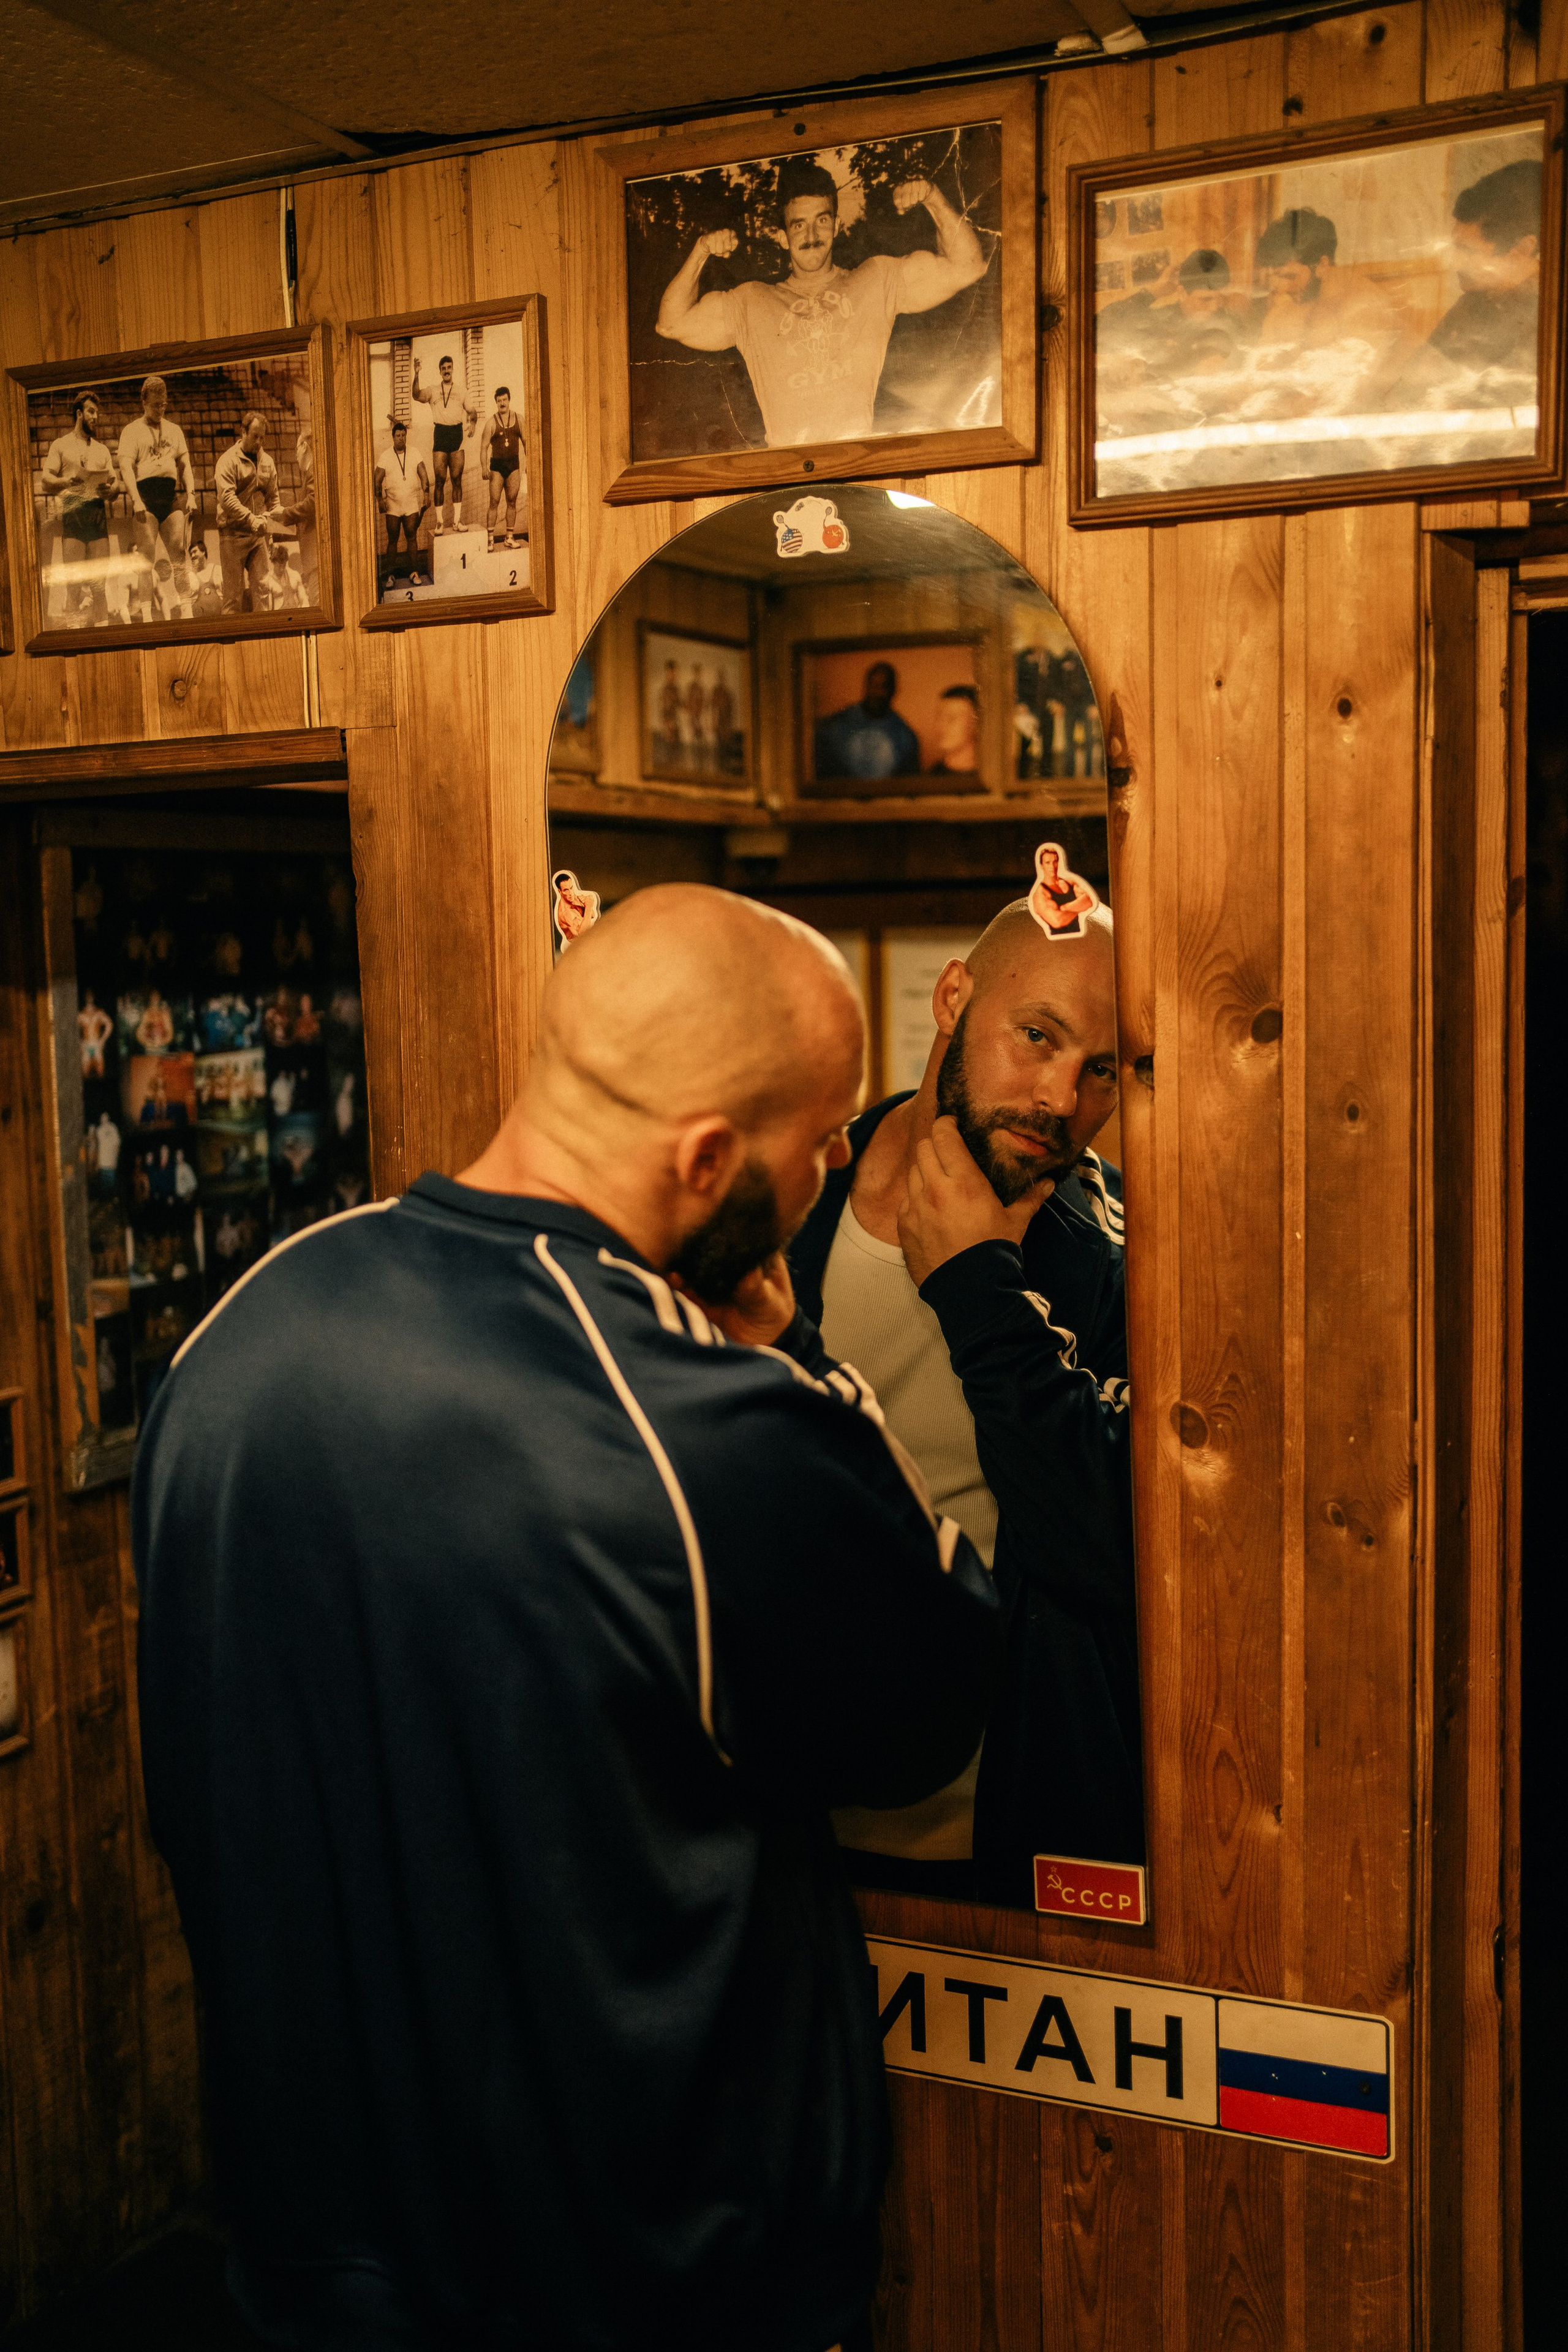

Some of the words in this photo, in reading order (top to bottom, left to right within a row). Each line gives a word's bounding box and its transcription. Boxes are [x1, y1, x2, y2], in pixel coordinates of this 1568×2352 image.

[461, 553, 466, 569] 1
[509, 570, 517, 586] 2
[1061, 1887, 1131, 1910] СССР
